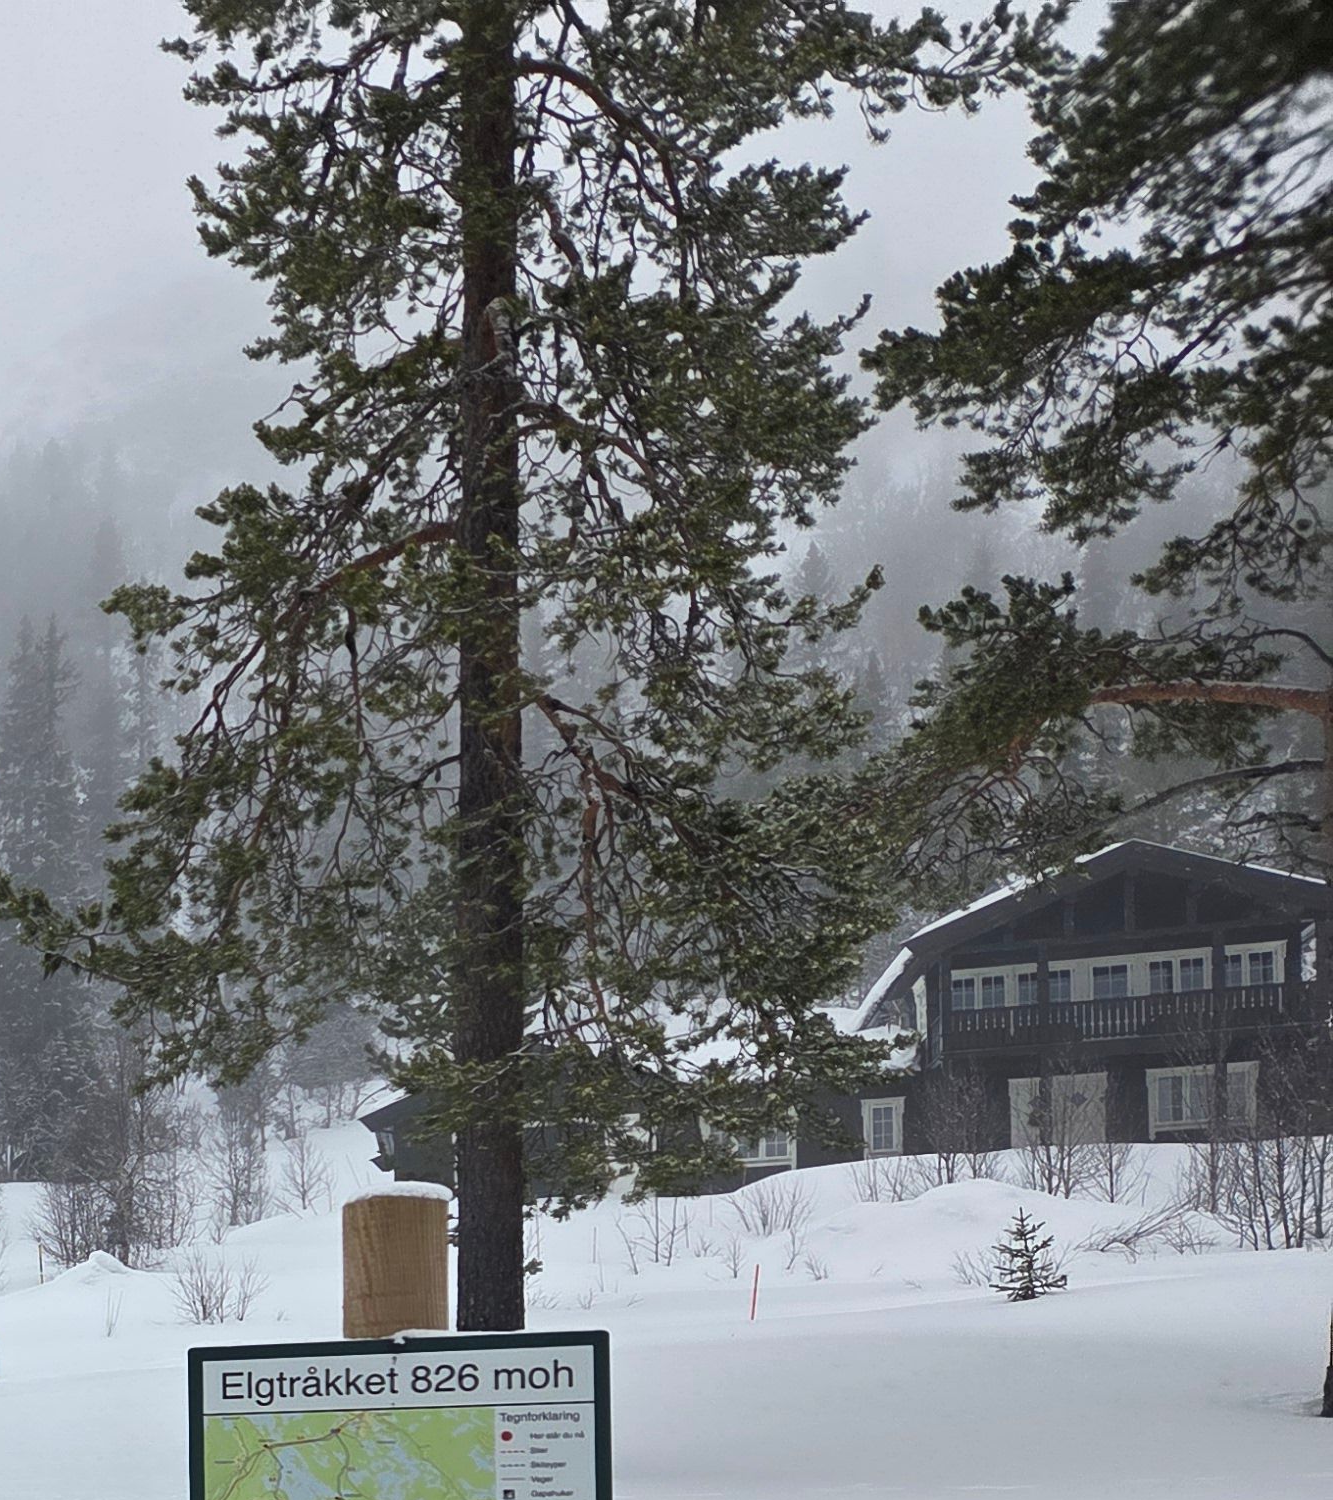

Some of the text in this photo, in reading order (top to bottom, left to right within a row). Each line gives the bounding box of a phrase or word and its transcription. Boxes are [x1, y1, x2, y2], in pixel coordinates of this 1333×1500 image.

[222, 1359, 574, 1406] Elgtråkket 826 moh
[499, 1411, 580, 1424] Tegnforklaring
